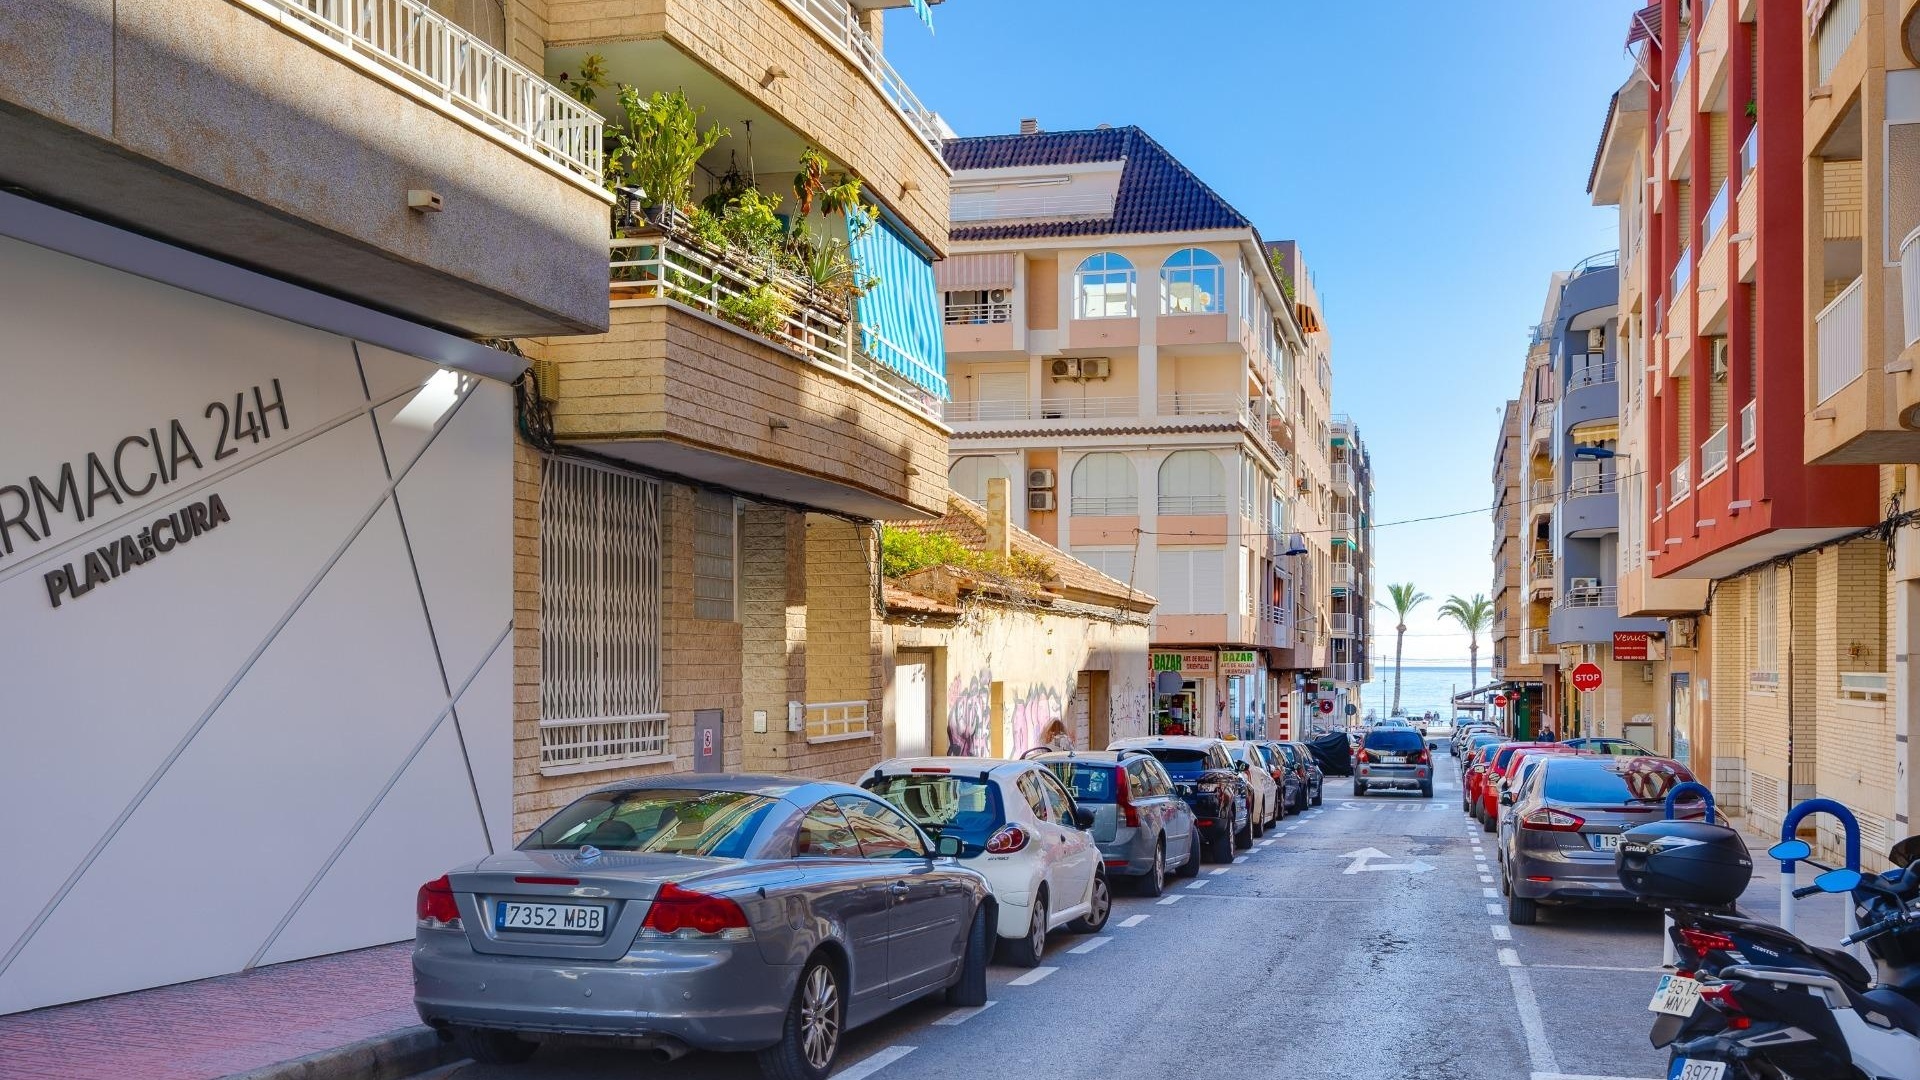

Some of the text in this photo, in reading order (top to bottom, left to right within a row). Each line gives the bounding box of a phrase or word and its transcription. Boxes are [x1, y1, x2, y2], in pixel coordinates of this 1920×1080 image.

[0, 378, 289, 557] RMACIA 24H
[44, 534, 146, 608] PLAYA
[151, 493, 231, 553] CURA
[1614, 633, 1647, 642] Venus
[1154, 654, 1182, 671] BAZAR
[1222, 652, 1253, 662] BAZAR
[1575, 674, 1600, 682] STOP
[1336, 801, 1449, 812] STOP
[1625, 845, 1647, 853] SHAD
[508, 905, 600, 929] 7352 MBB
[1667, 979, 1700, 998] 9514
[1663, 995, 1692, 1013] MNY
[1684, 1064, 1719, 1080] 3971
